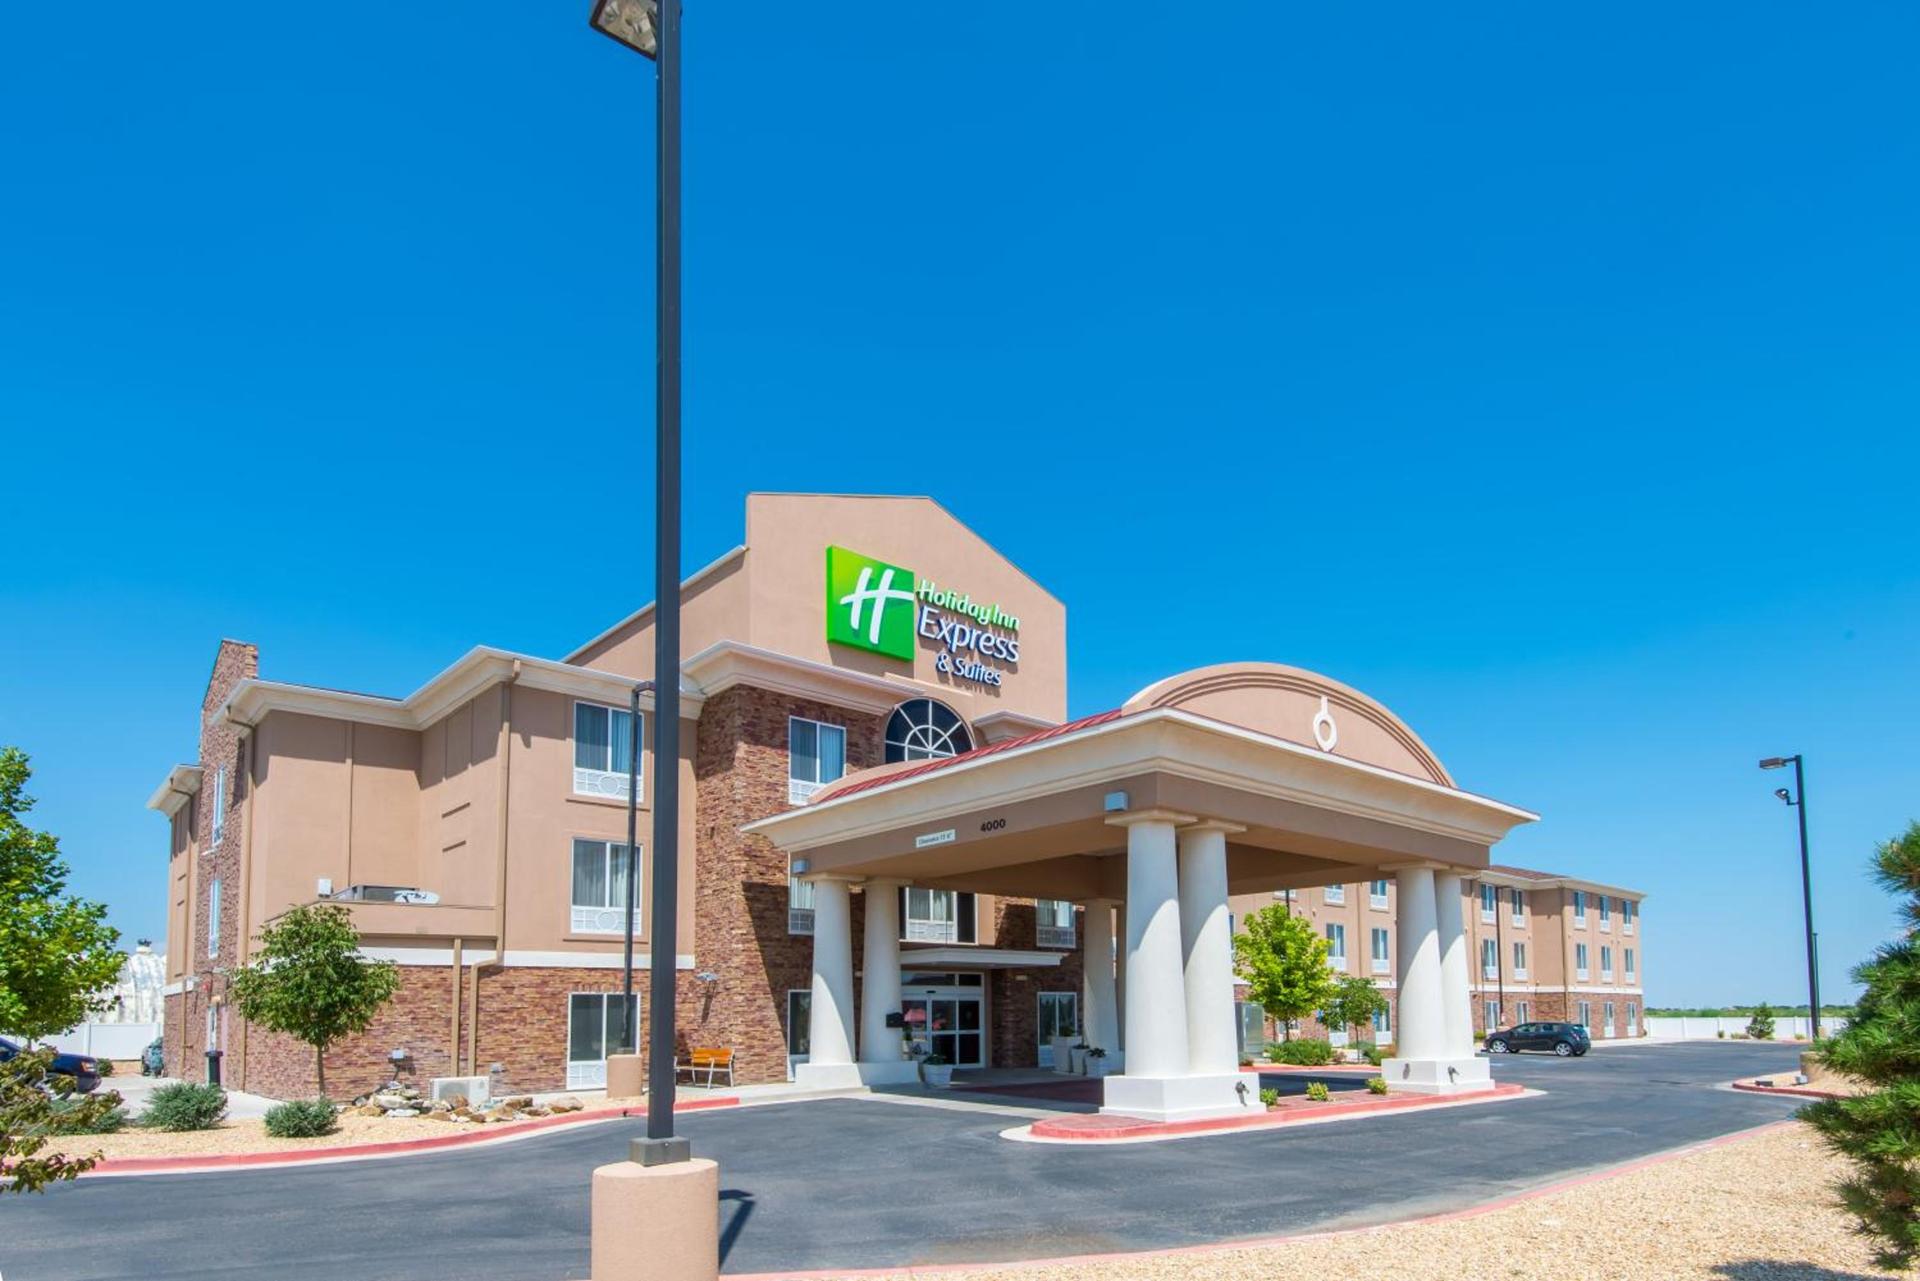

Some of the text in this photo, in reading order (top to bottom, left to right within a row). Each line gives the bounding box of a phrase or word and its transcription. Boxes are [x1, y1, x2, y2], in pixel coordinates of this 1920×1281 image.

[917, 579, 1020, 630] Holiday Inn
[918, 605, 1020, 663] Express
[936, 653, 1002, 686] & Suites
[981, 818, 1006, 832] 4000
